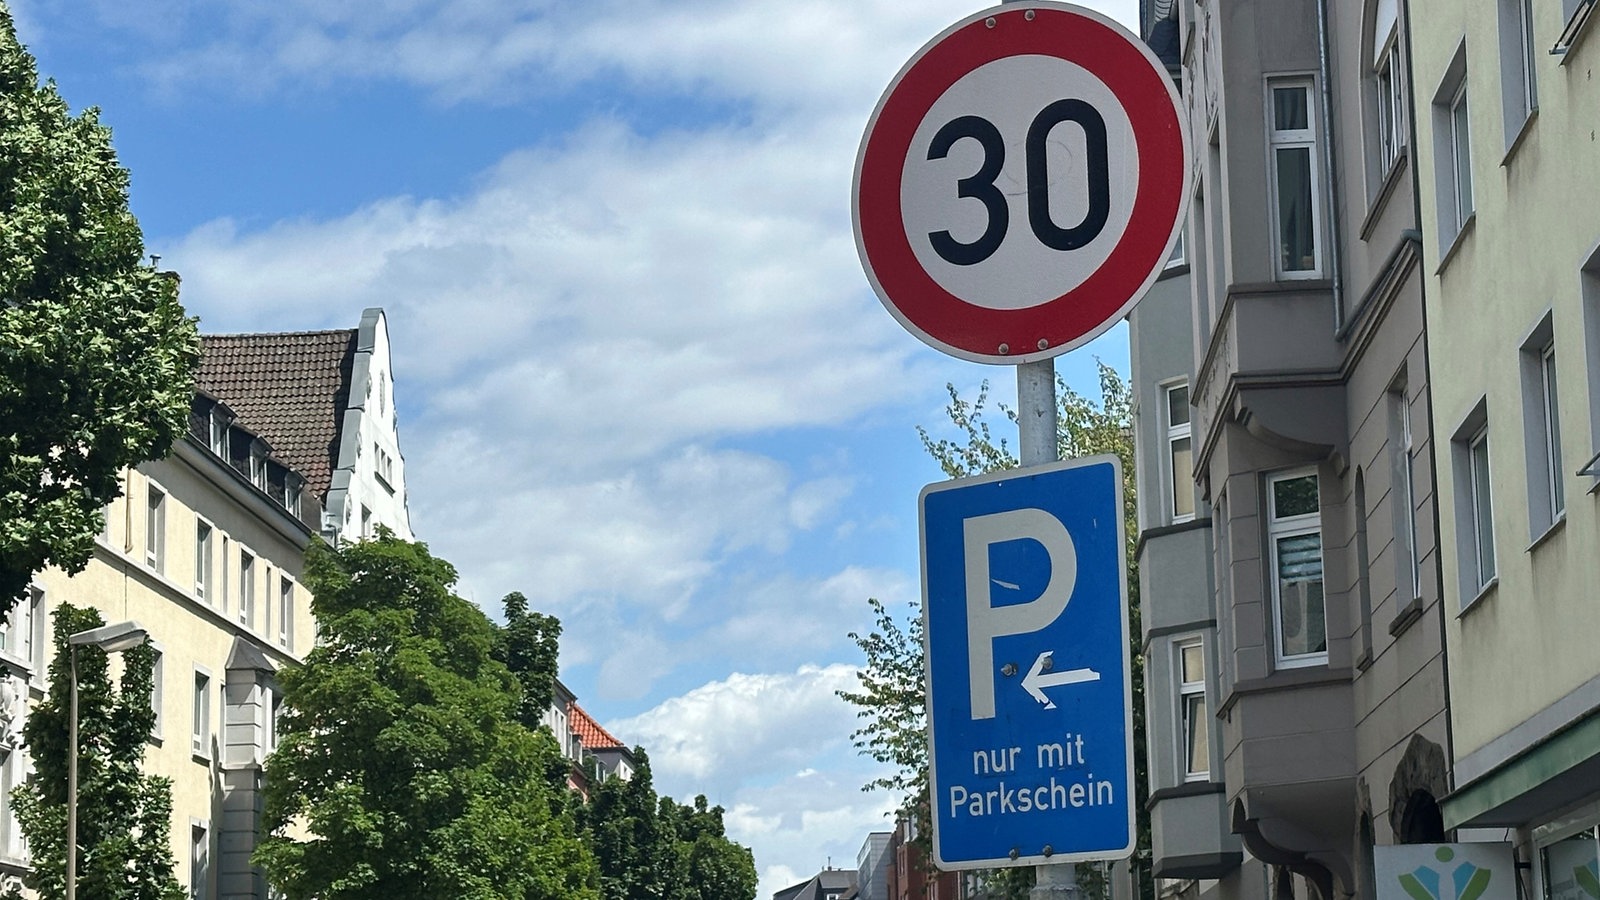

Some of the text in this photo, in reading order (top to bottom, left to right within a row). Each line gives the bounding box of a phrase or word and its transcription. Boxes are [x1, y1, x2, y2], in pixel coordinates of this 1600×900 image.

[926, 98, 1111, 266] 30
[963, 507, 1077, 721] P
[950, 773, 1113, 818] Parkschein
[973, 732, 1085, 775] nur mit
